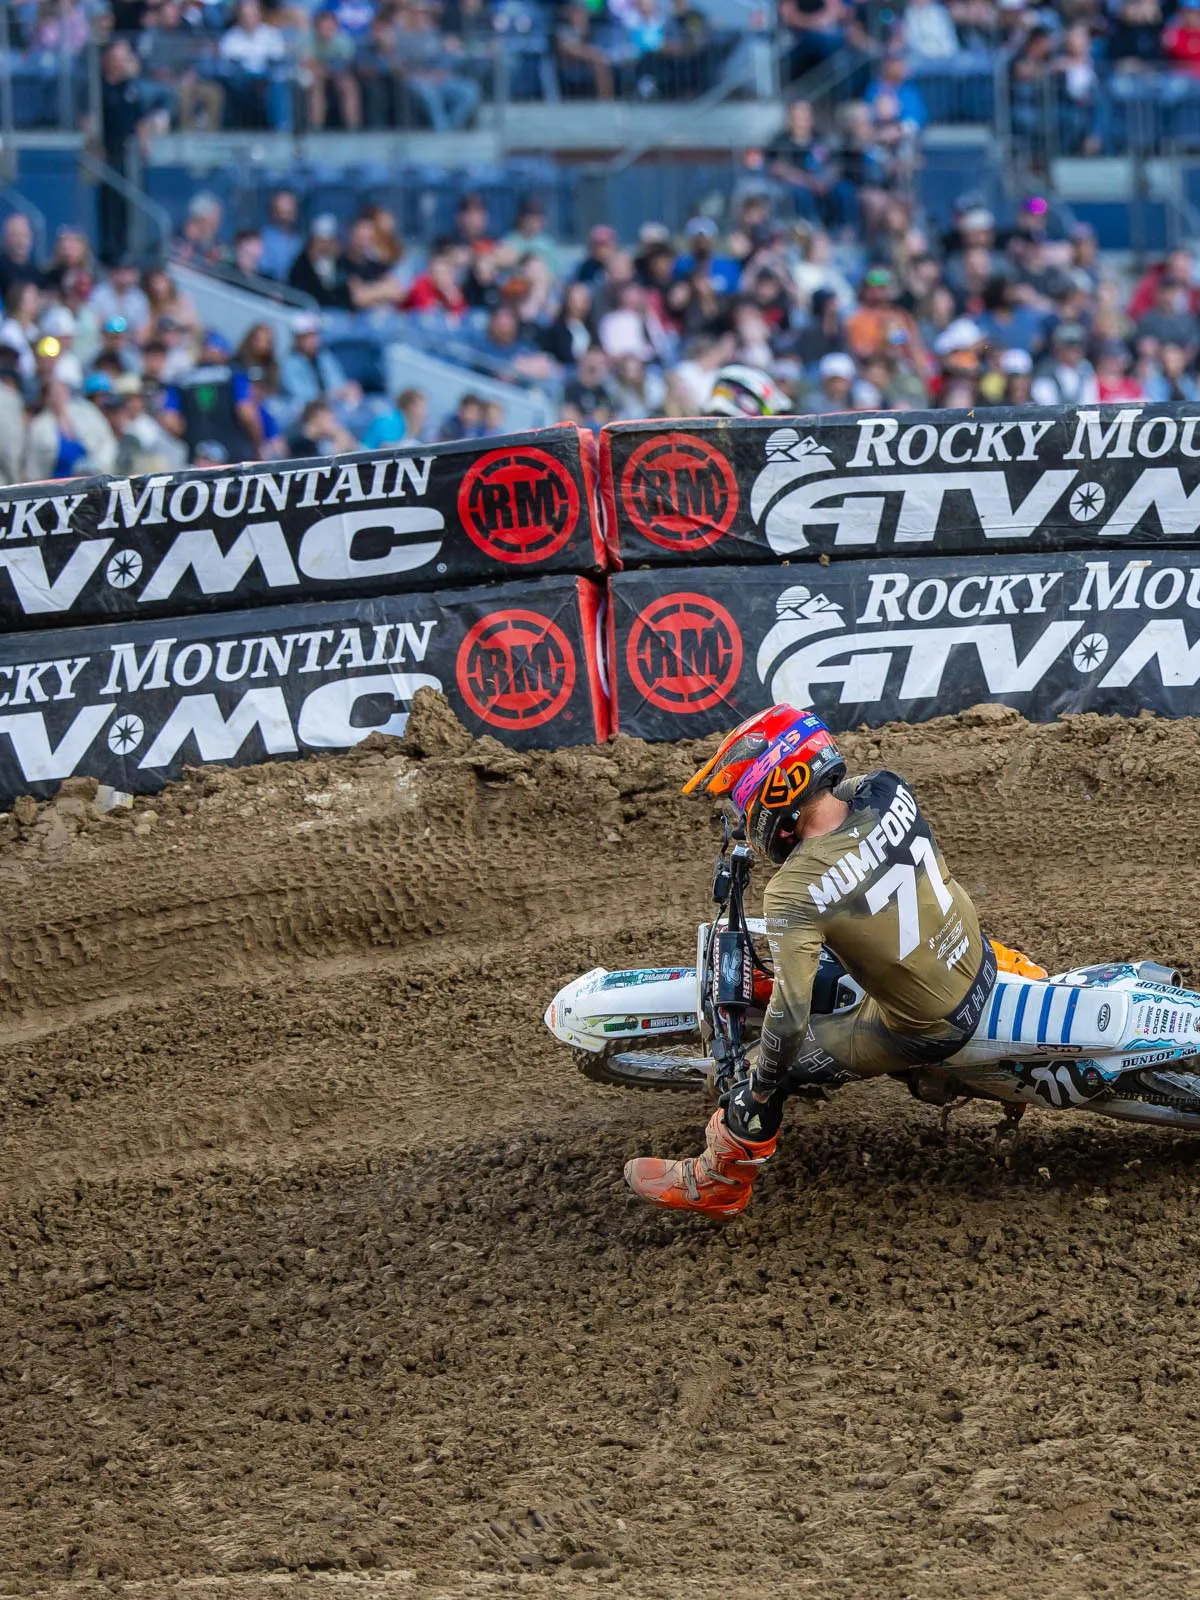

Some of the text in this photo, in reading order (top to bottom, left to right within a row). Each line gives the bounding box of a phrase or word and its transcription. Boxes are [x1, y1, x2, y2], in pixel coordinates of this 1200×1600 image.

[846, 417, 1056, 467] ROCKY
[97, 455, 437, 530] MOUNTAIN
[481, 478, 553, 530] RM
[646, 467, 717, 518] RM
[856, 572, 1064, 624] ROCKY
[99, 620, 438, 696] MOUNTAIN
[478, 643, 551, 697] RM
[649, 628, 722, 679] RM
[807, 784, 918, 914] MUMFORD
[864, 835, 954, 961] 71
[742, 940, 752, 1000] RENTHA
[1122, 1050, 1175, 1068] DUNLOP
